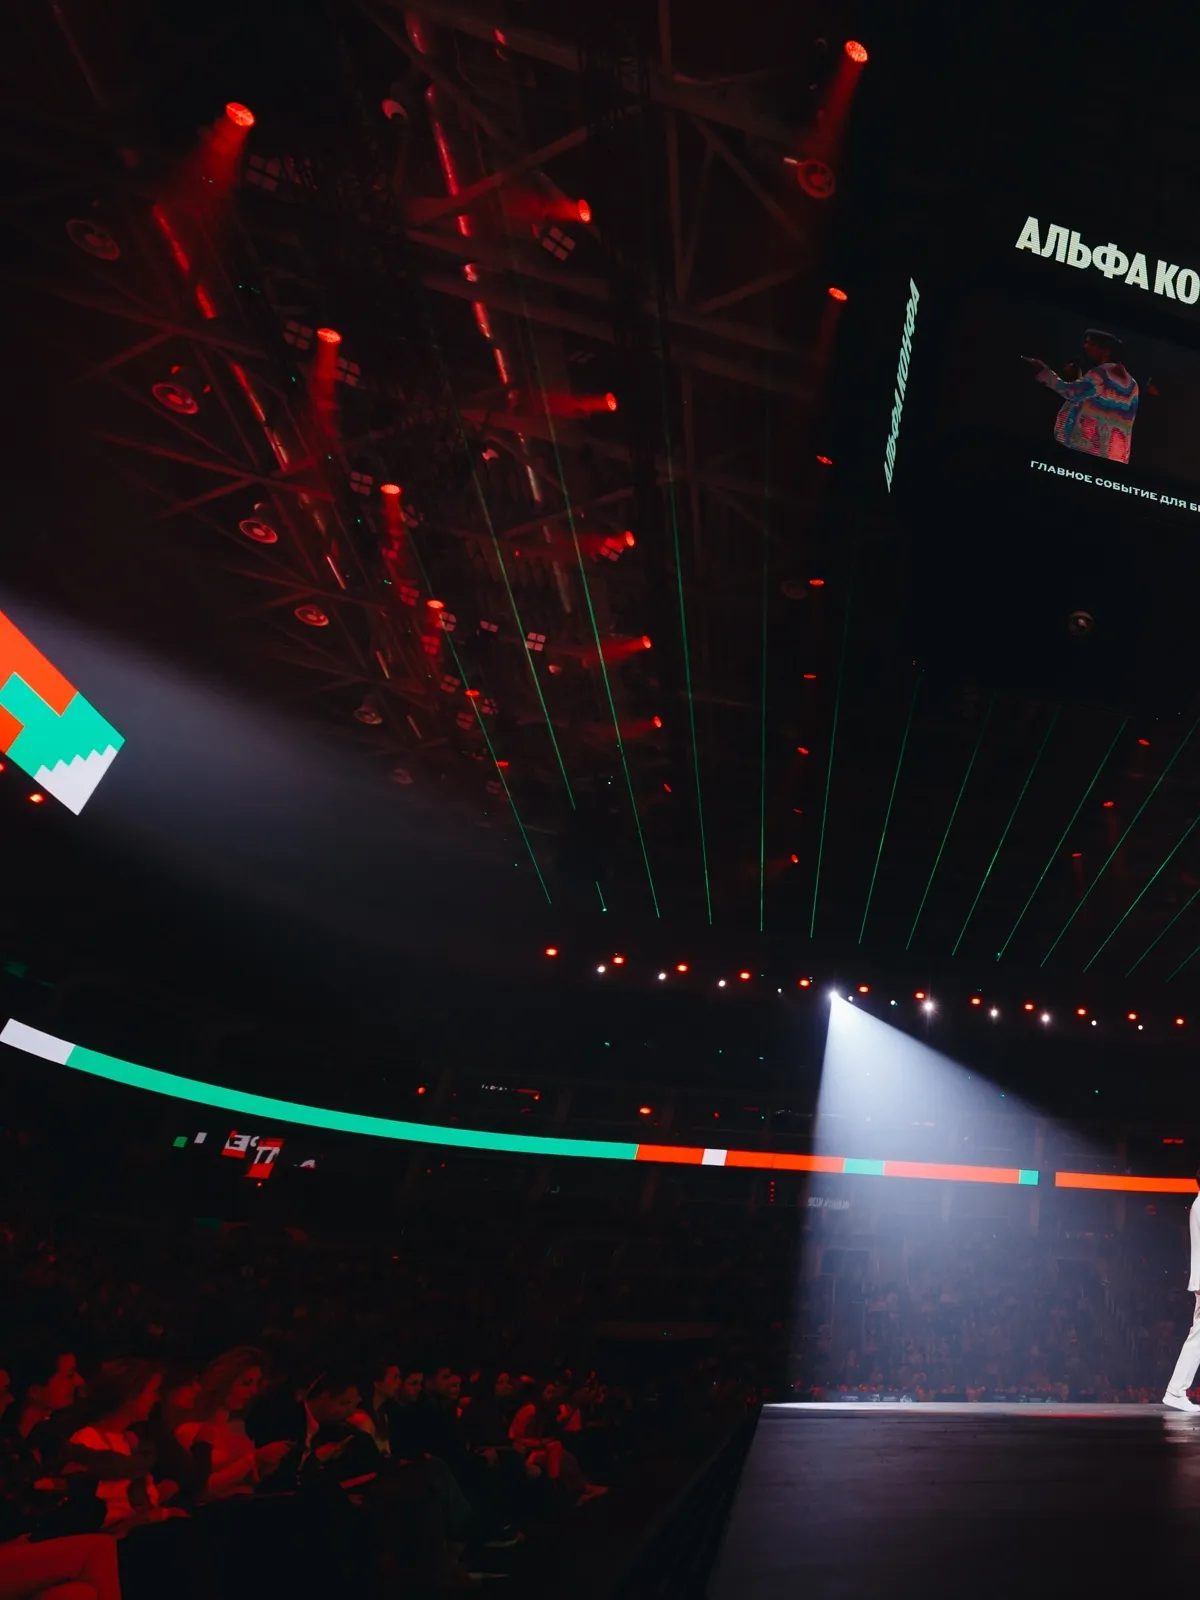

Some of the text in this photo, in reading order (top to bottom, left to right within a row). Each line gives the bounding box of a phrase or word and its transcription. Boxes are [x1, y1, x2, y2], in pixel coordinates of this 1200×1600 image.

[1014, 215, 1149, 291] АЛЬФА
[884, 277, 920, 494] АЛЬФА КОНФА
[1030, 460, 1093, 484] ГЛАВНОЕ
[1095, 477, 1158, 501] СОБЫТИЕ
[1159, 494, 1187, 509] ДЛЯ
